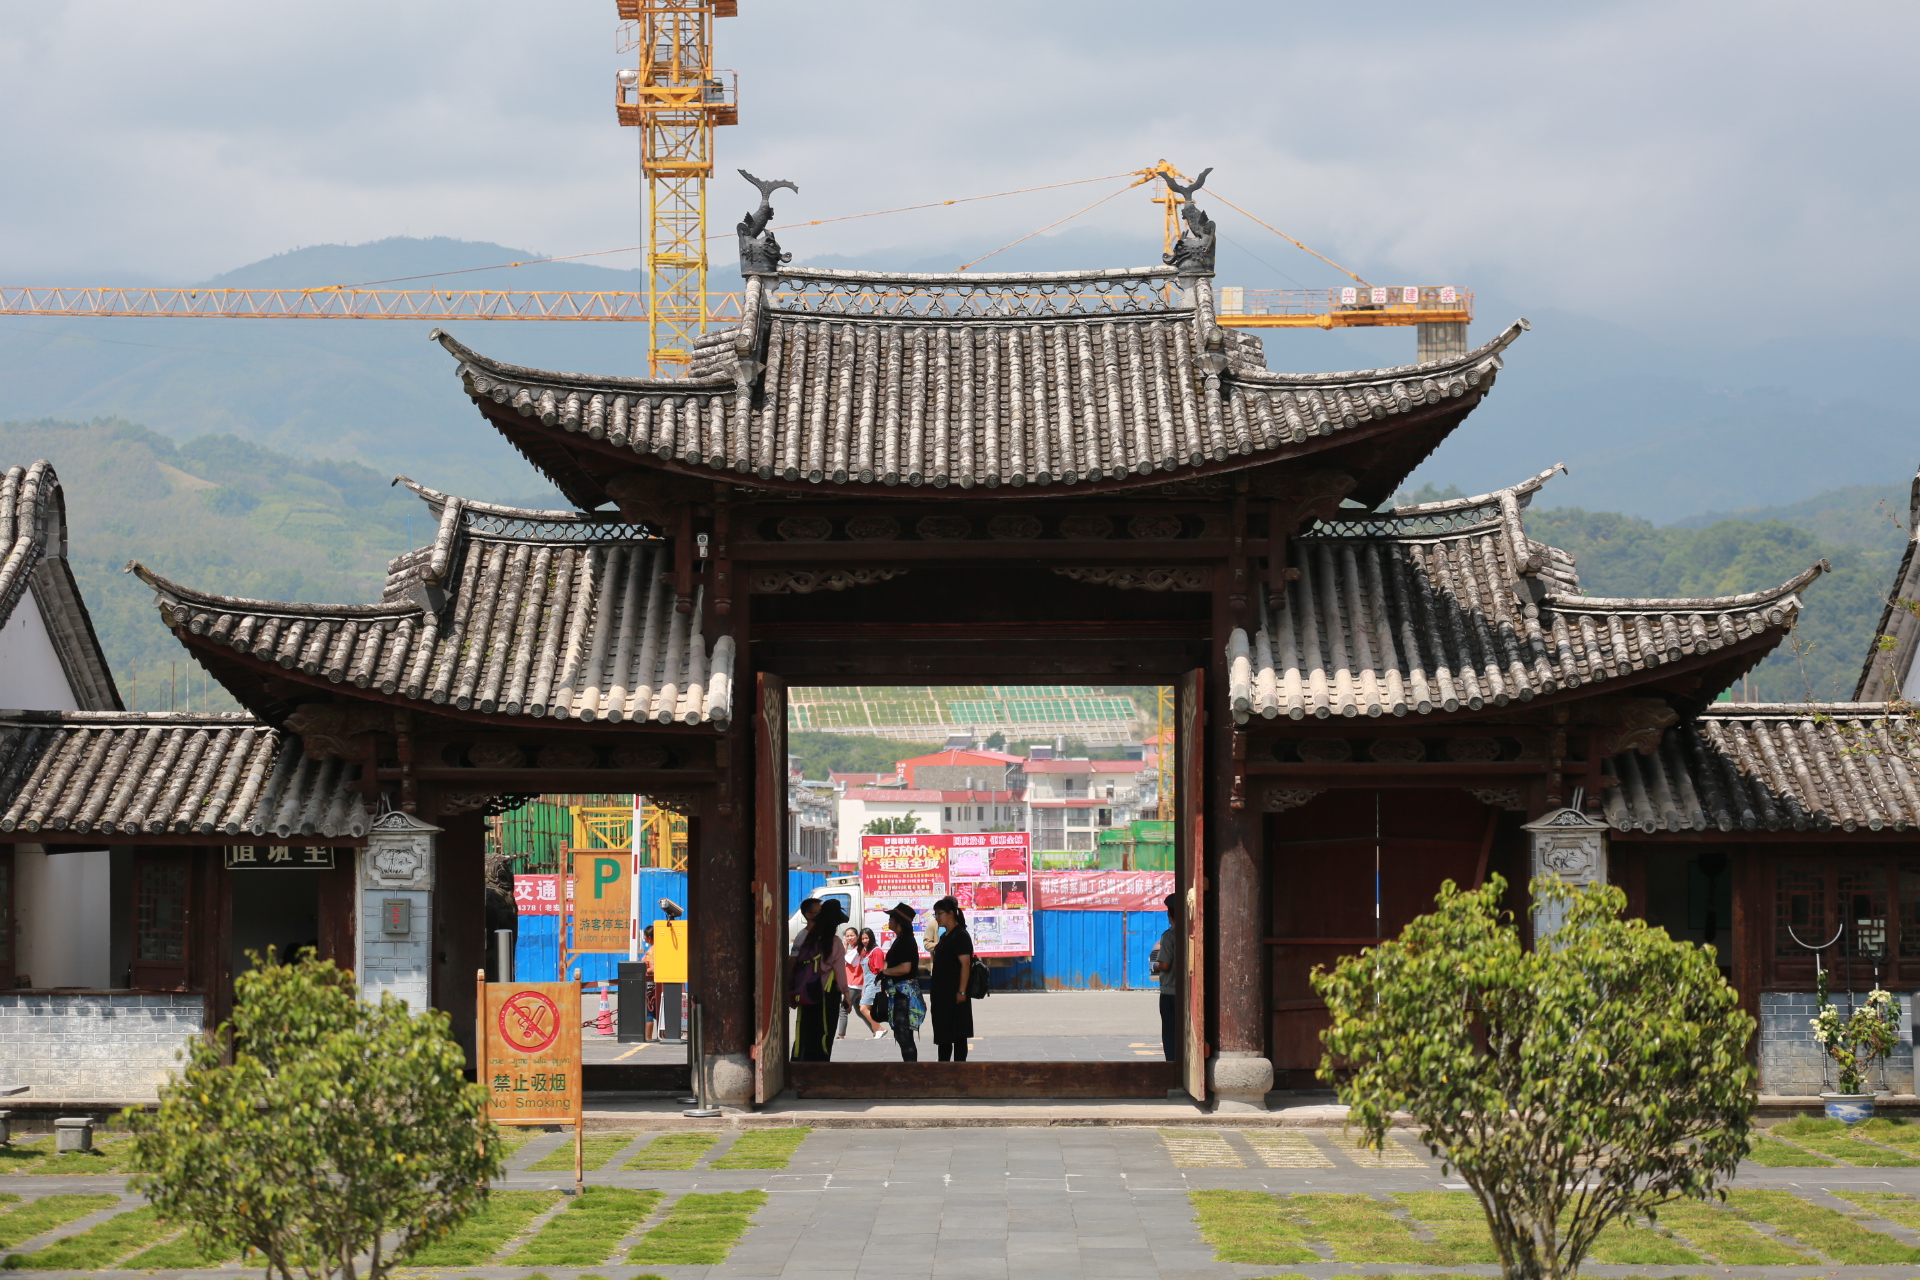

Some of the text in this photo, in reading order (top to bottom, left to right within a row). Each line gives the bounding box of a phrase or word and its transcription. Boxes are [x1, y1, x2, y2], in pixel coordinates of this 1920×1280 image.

[869, 845, 929, 858] 国庆放价
[879, 857, 940, 870] 钜惠全城
[593, 858, 621, 899] P
[579, 933, 598, 942] Visitors
[601, 934, 620, 944] parking
[494, 1073, 566, 1092] 禁止吸烟
[488, 1097, 571, 1110] No Smoking
